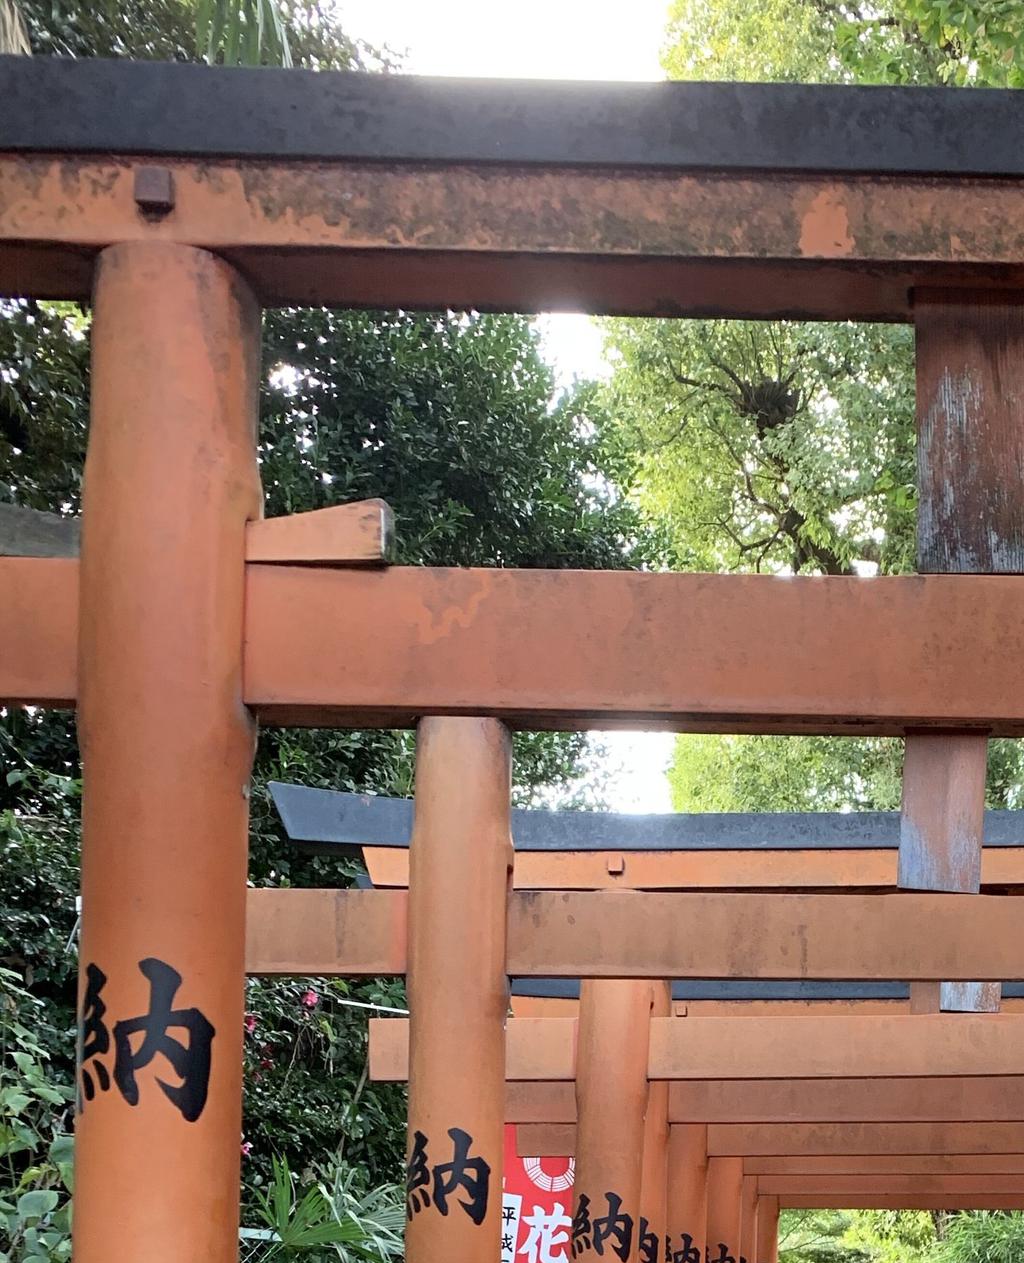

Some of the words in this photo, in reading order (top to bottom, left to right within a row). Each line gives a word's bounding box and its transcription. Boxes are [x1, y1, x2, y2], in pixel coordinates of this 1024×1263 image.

[76, 957, 216, 1122] 納
[405, 1129, 491, 1226] 納
[572, 1192, 634, 1263] 納
